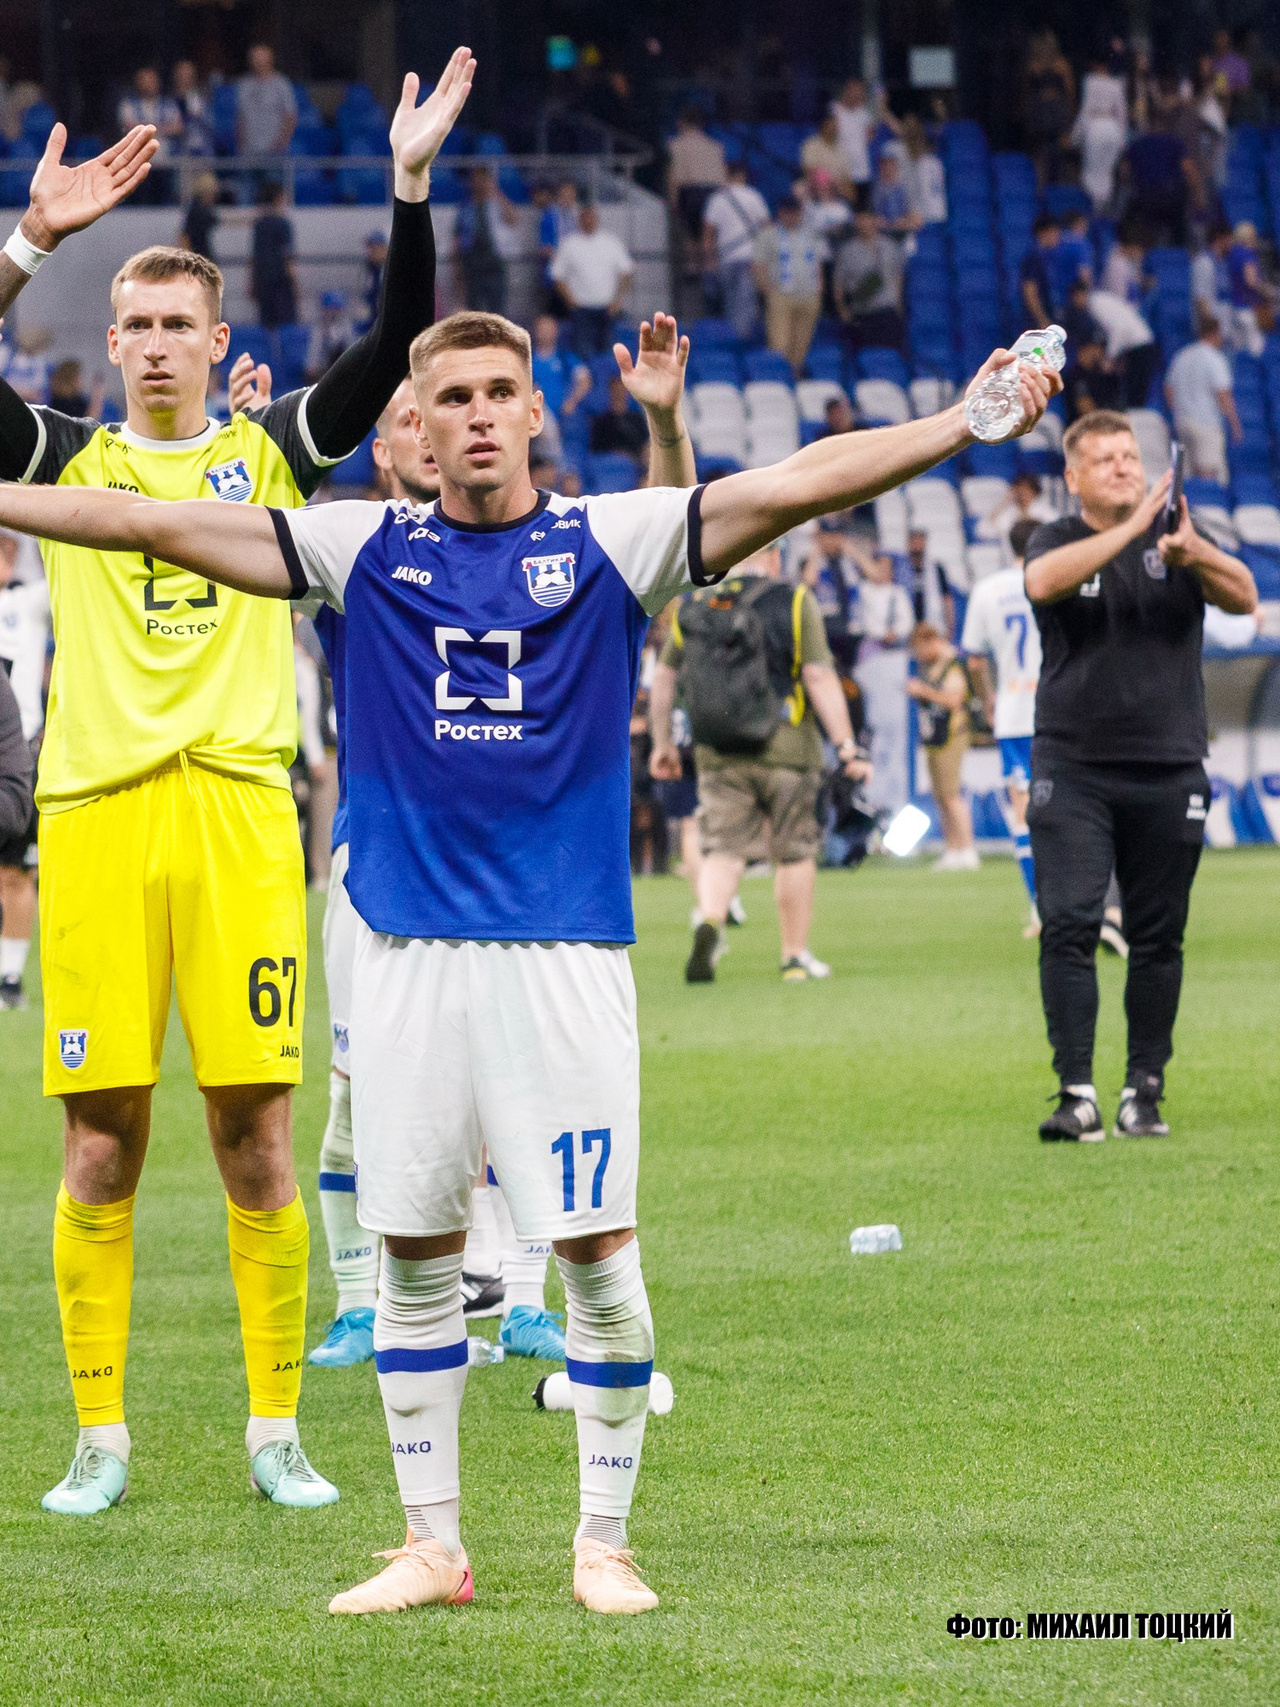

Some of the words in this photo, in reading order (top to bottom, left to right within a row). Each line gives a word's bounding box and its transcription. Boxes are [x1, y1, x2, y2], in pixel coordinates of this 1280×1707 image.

[391, 566, 433, 586] JAKO
[146, 618, 218, 635] Ростех
[434, 719, 523, 740] Ростех
[248, 956, 297, 1027] 67
[279, 1045, 300, 1058] JAKO
[551, 1128, 611, 1211] 17
[335, 1246, 372, 1261] JAKO
[272, 1356, 304, 1371] JAK
[72, 1365, 113, 1379] JAKO
[391, 1440, 432, 1455] JAKO
[588, 1454, 633, 1469] JAKO
